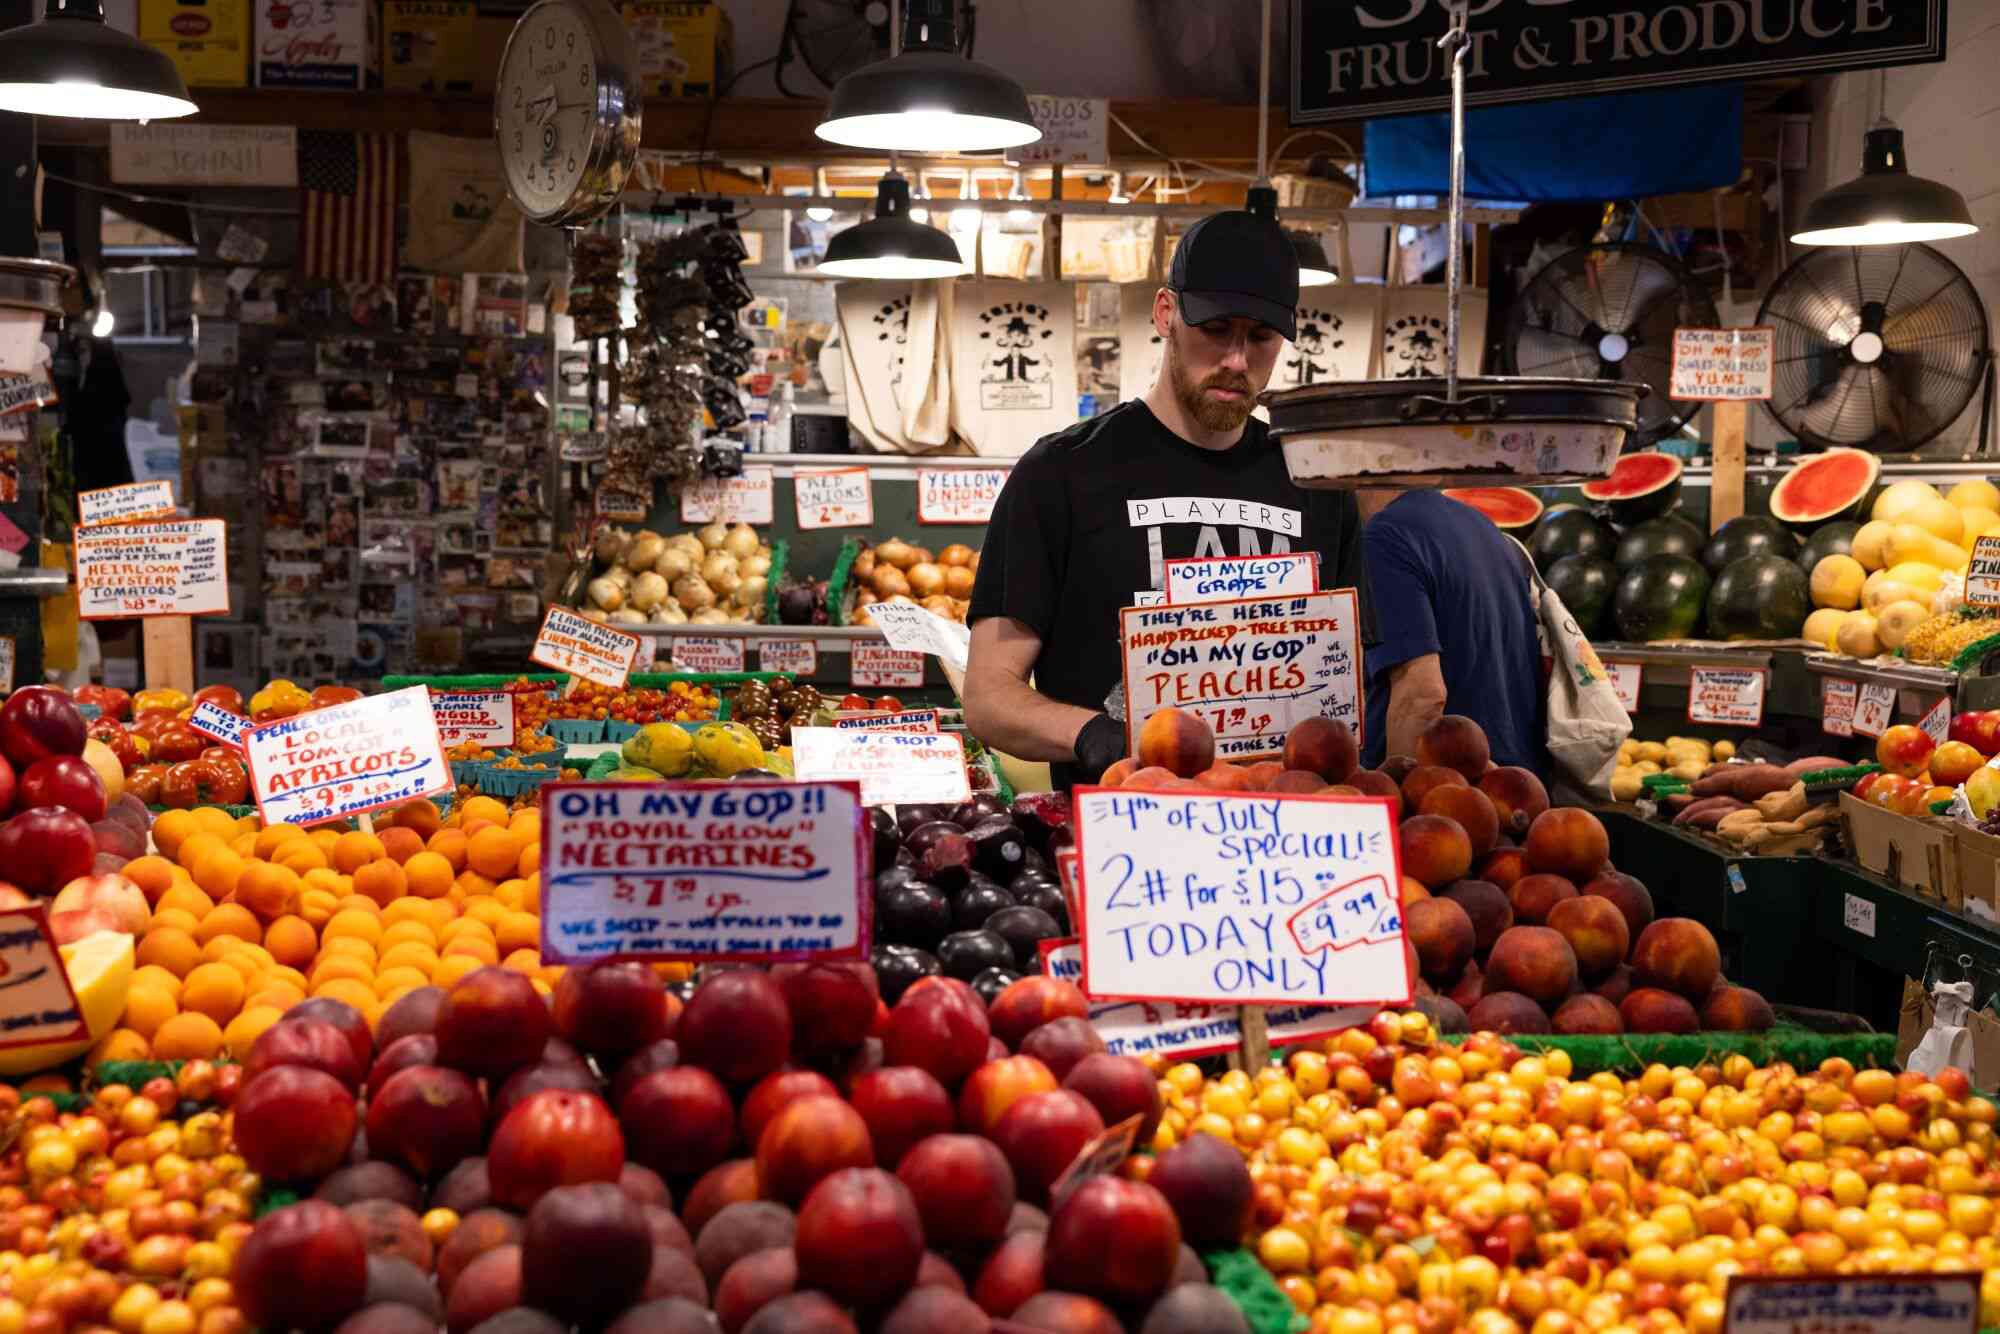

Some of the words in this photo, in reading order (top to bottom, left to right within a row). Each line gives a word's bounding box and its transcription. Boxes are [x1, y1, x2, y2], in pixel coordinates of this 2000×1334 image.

[545, 27, 556, 49] 0
[566, 33, 575, 54] 9
[1327, 30, 1498, 94] FRUIT
[1513, 25, 1557, 70] &
[1570, 0, 1893, 66] PRODUCE
[528, 47, 534, 68] 1
[580, 64, 589, 86] 8
[514, 87, 522, 108] 2
[582, 110, 591, 133] 7
[514, 131, 522, 152] 3
[527, 164, 536, 183] 4
[567, 157, 576, 173] 6
[547, 169, 556, 191] 5
[927, 474, 1001, 488] YELLOW
[800, 486, 864, 505] ONIONS
[926, 488, 996, 504] ONIONS
[1135, 501, 1294, 530] PLAYERS
[88, 564, 181, 576] HEIRLOOM
[1172, 564, 1212, 579] "OH
[1219, 561, 1246, 582] MY
[83, 576, 177, 588] BEEFSTEAK
[91, 587, 177, 598] TOMATOES
[1196, 576, 1267, 597] GRAPE
[1139, 607, 1217, 627] THEY'RE
[1292, 618, 1339, 632] RIPE
[1147, 646, 1199, 666] "OH
[1209, 642, 1246, 666] MY
[856, 660, 921, 673] POTATOES
[1145, 662, 1306, 705] PEACHES
[431, 703, 483, 711] RGANIC
[839, 715, 897, 729] ORGANIC
[1250, 712, 1273, 734] LB
[284, 722, 374, 749] LOCAL
[1219, 735, 1265, 754] TAKE
[268, 745, 418, 794] APRICOTS
[559, 792, 620, 819] OH
[641, 793, 703, 819] MY
[1111, 797, 1160, 832] 4th
[1167, 801, 1201, 830] of
[560, 843, 817, 870] NECTARINES
[1184, 873, 1225, 911] for
[560, 919, 597, 936] WE
[605, 916, 660, 934] SHIP
[786, 915, 814, 928] TO
[1106, 913, 1275, 963] TODAY
[1214, 949, 1328, 996] ONLY
